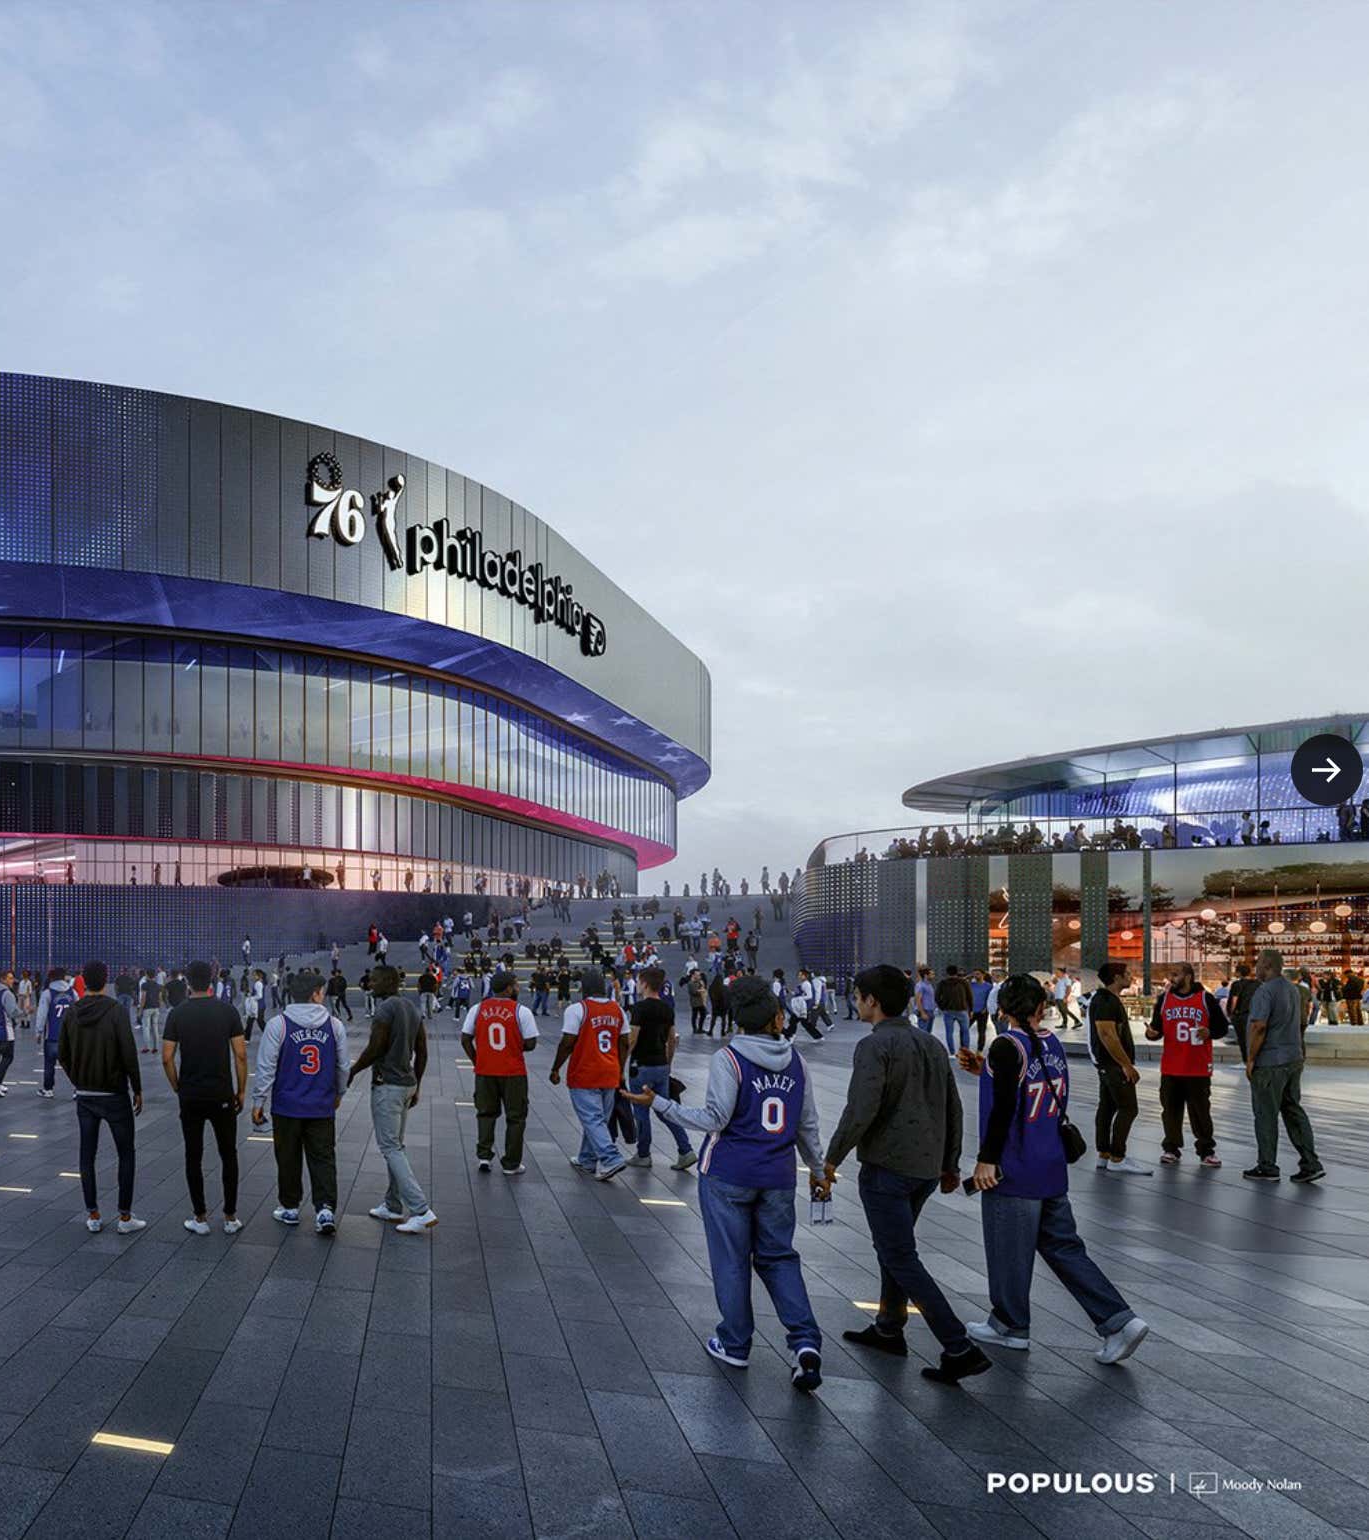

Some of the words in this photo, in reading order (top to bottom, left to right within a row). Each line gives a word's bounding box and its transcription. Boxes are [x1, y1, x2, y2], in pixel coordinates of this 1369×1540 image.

[310, 480, 366, 545] 76
[408, 518, 584, 637] philadelphia
[1166, 1006, 1203, 1022] SIXERS
[289, 1029, 330, 1044] IVERSON
[488, 1022, 507, 1051] 0
[598, 1030, 611, 1053] 6
[300, 1044, 320, 1075] 3
[751, 1073, 796, 1094] MAXEY
[761, 1096, 786, 1134] 0
